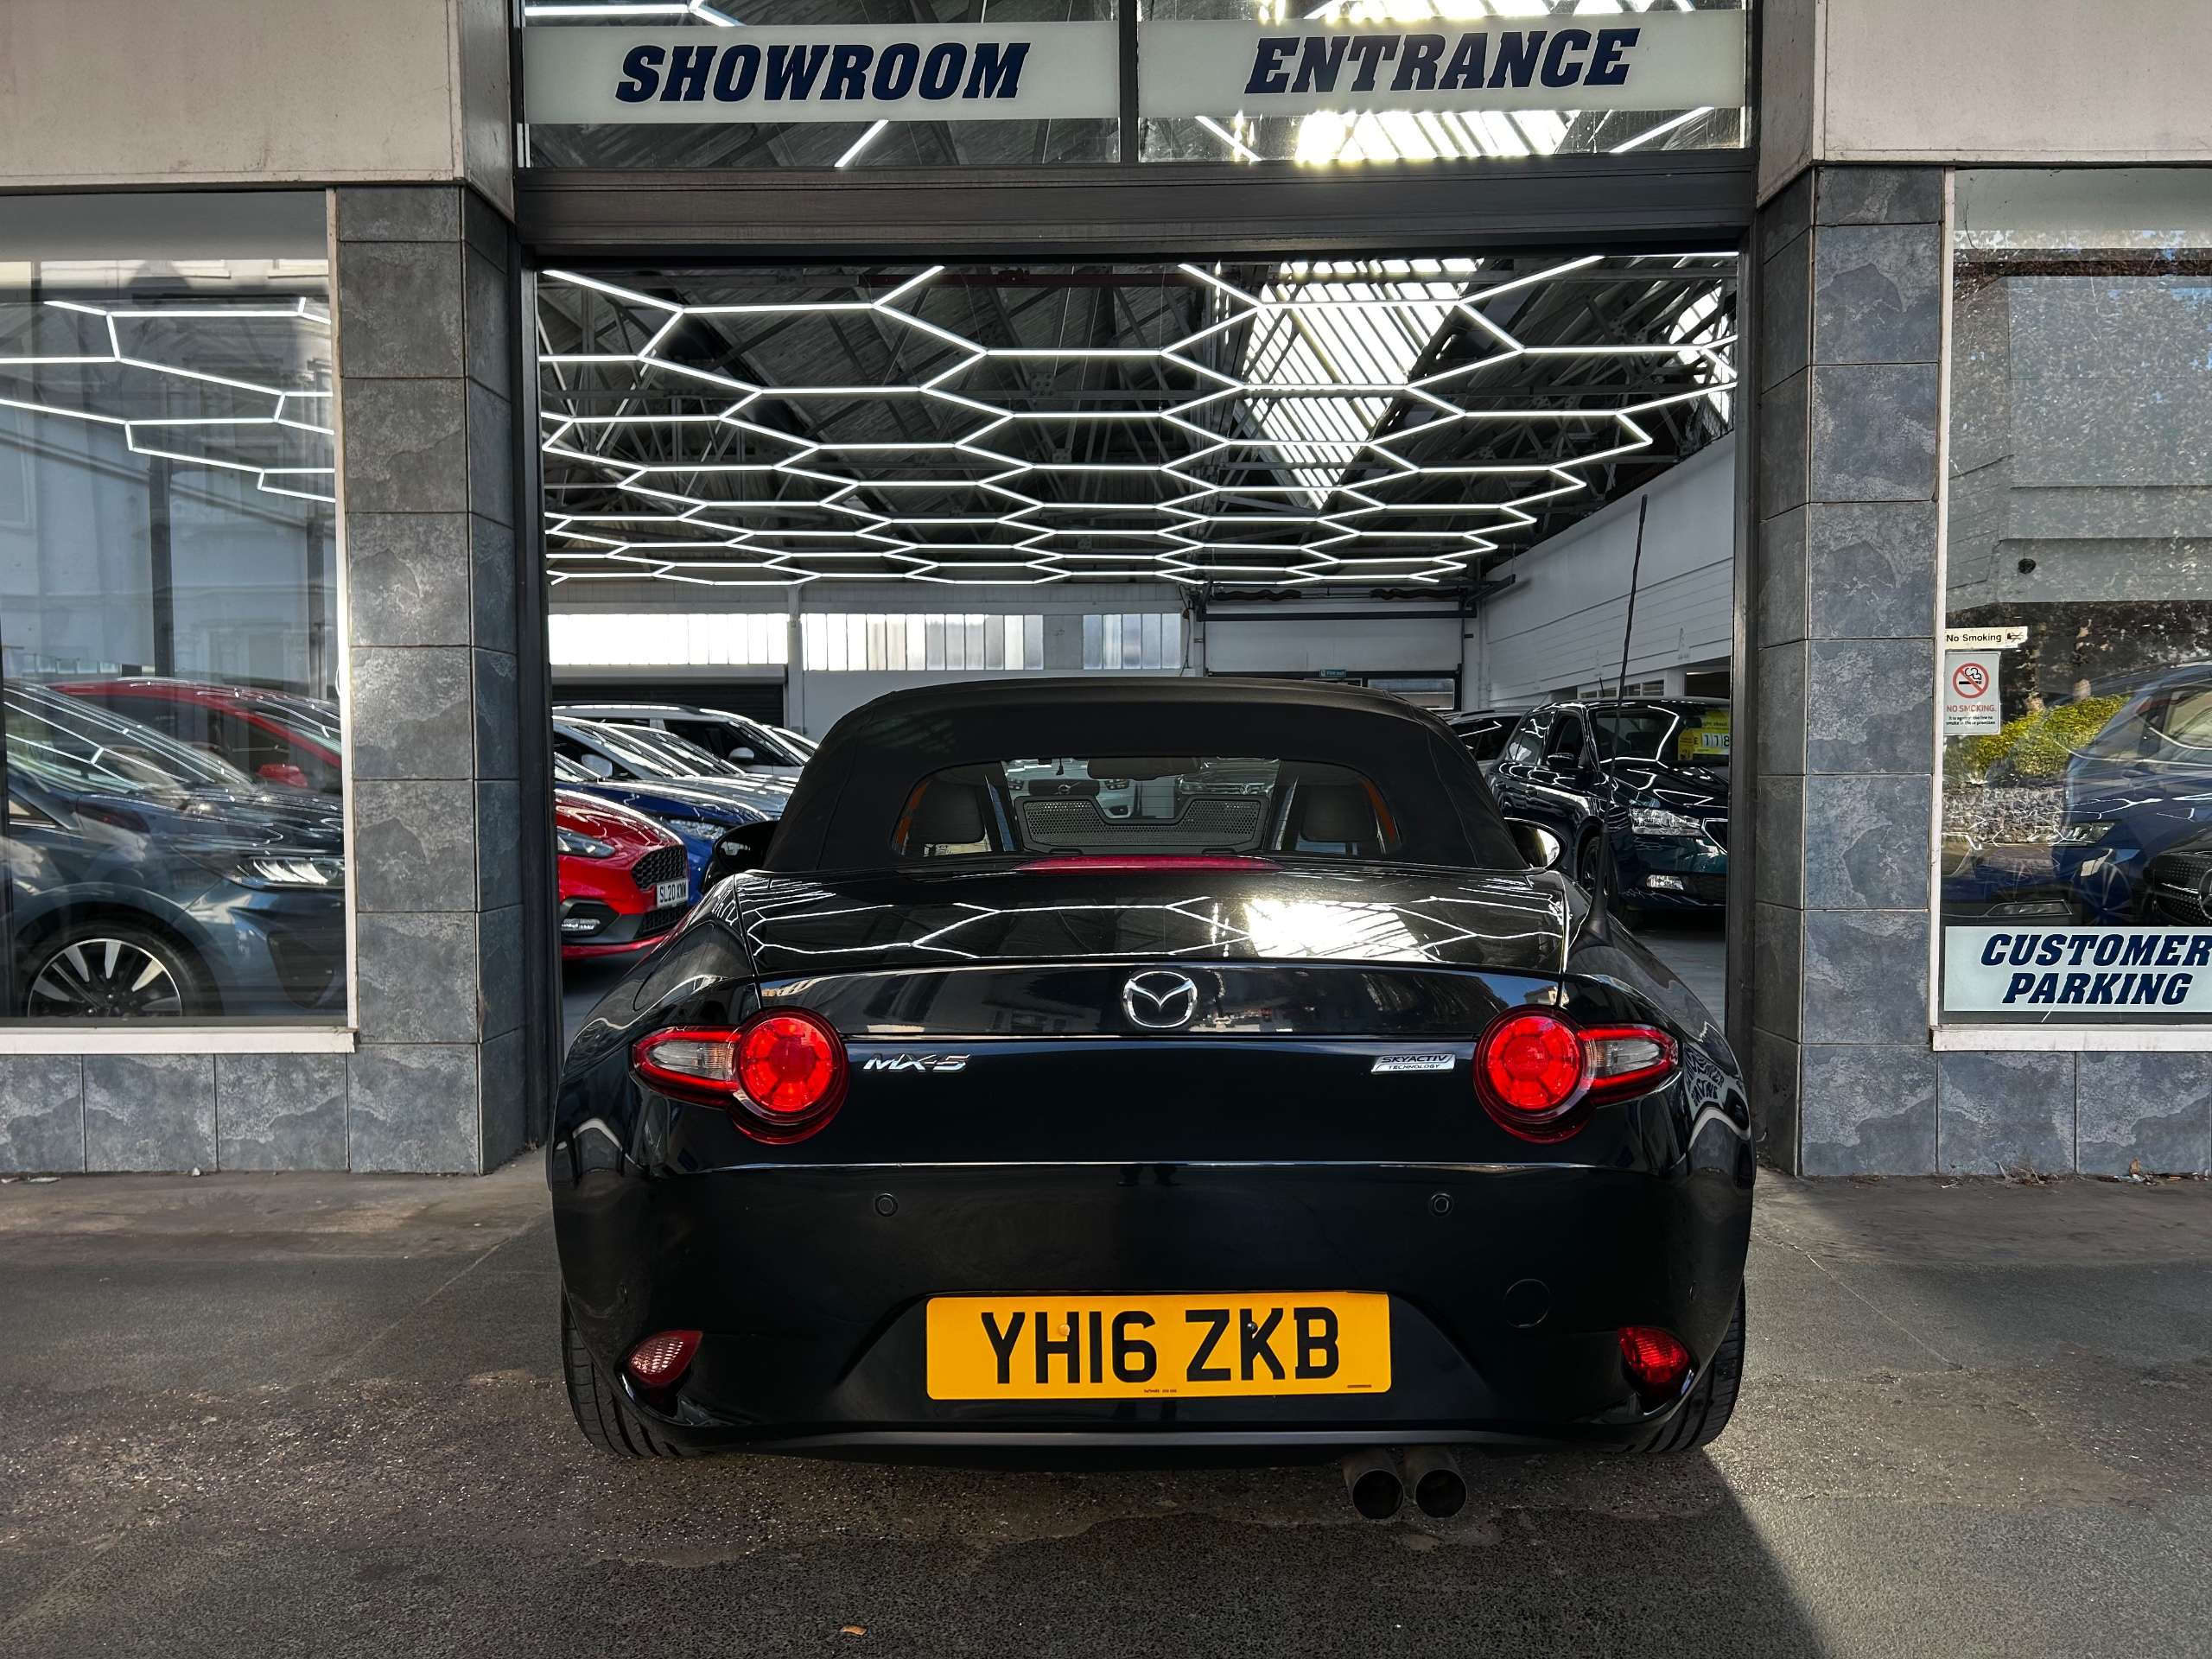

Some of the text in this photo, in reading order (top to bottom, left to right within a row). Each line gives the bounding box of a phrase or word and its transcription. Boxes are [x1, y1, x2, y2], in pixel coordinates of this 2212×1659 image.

[615, 42, 1031, 103] SHOWROOM
[1244, 28, 1641, 94] ENTRANCE
[1962, 633, 2002, 643] Smoking
[1980, 933, 2212, 966] CUSTOMER
[2001, 972, 2194, 1005] PARKING
[863, 1053, 970, 1071] MX-5
[1382, 1054, 1449, 1063] SKYACTIV
[981, 1306, 1339, 1384] YH16 ZKB
